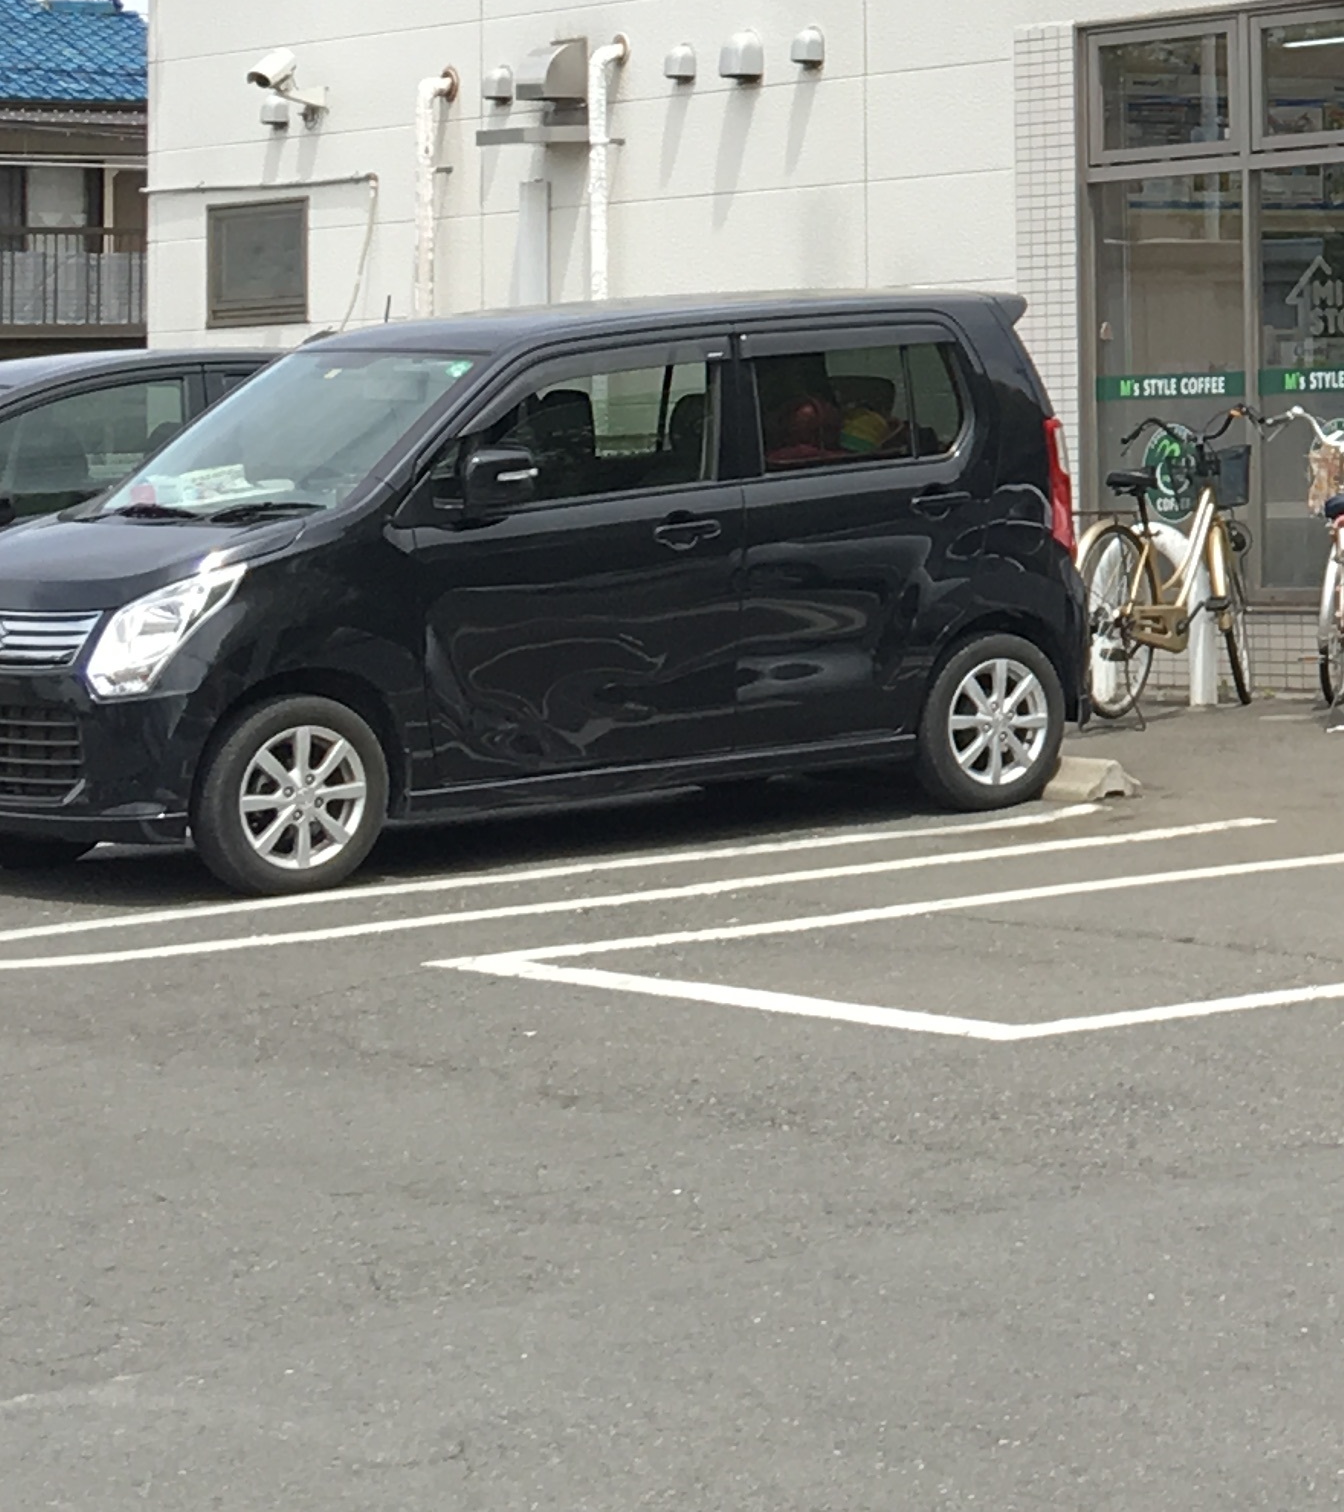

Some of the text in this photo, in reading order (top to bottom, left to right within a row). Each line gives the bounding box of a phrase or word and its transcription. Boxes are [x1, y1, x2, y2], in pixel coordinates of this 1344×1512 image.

[1120, 376, 1226, 397] M's STYLE COFFEE
[1285, 372, 1306, 390] M's
